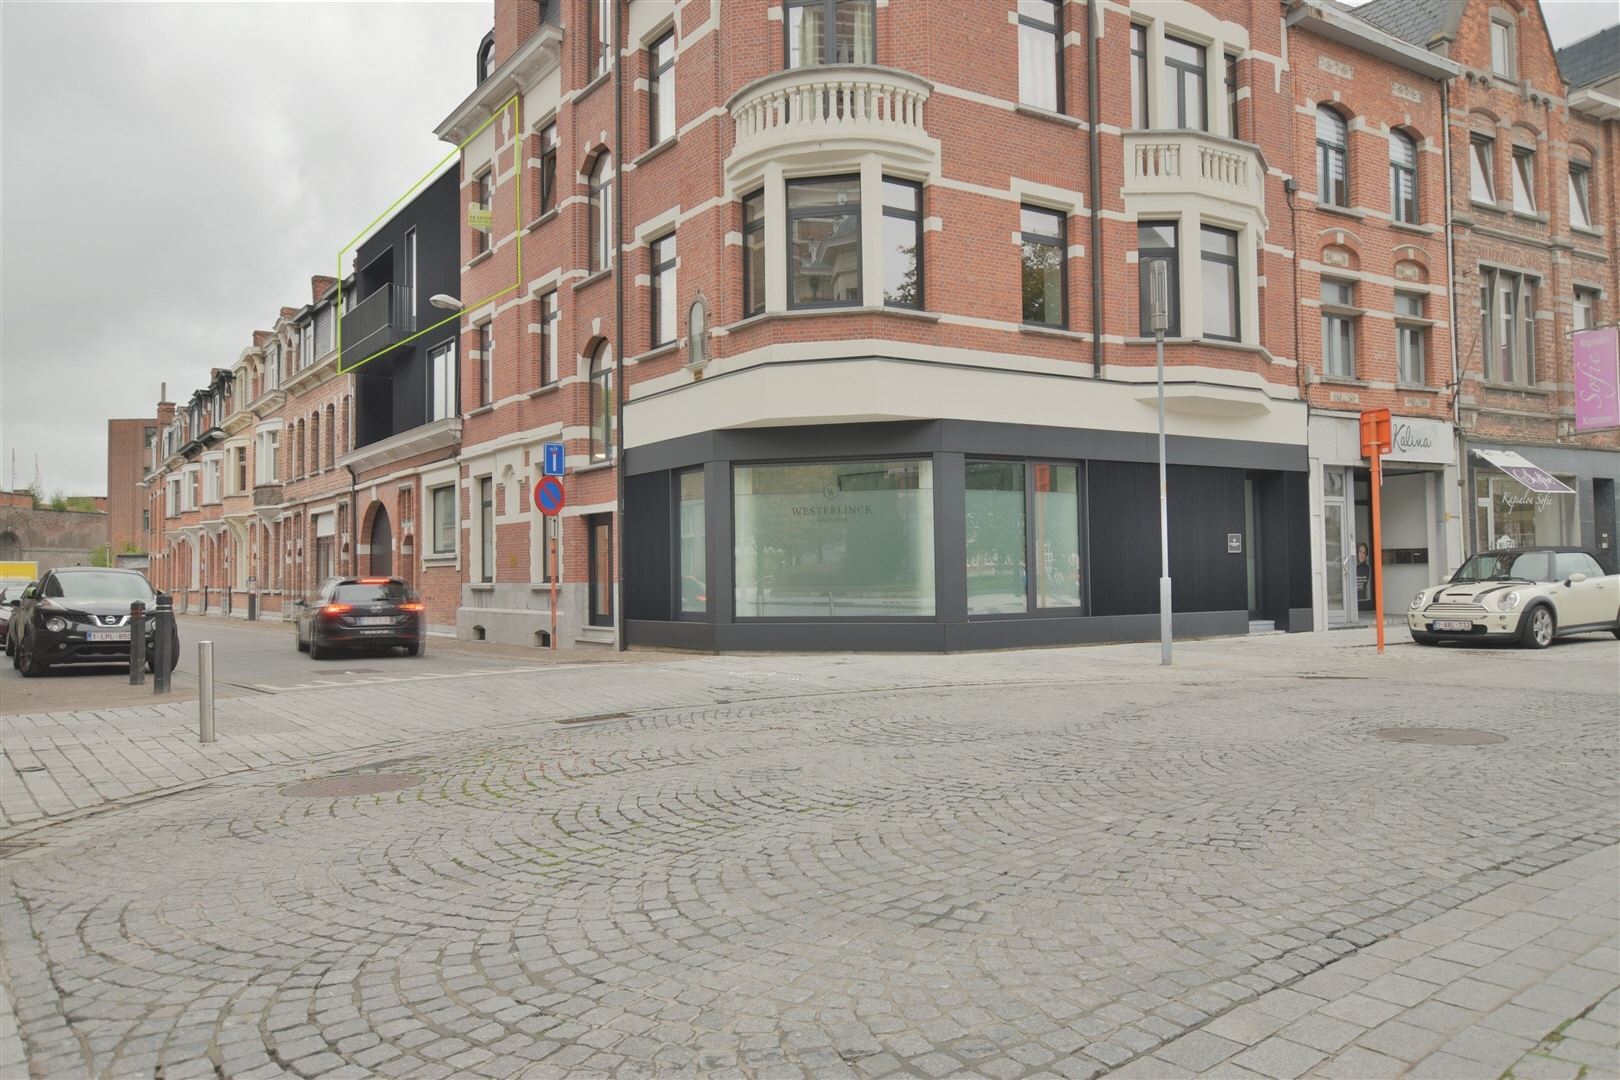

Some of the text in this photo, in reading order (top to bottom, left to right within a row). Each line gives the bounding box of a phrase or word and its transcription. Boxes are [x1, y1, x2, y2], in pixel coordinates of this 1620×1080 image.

[1577, 352, 1616, 409] Sofie
[1393, 423, 1432, 453] Kalina
[791, 504, 873, 516] WESTERLINCK
[1502, 488, 1553, 515] Kapsalon Sofie
